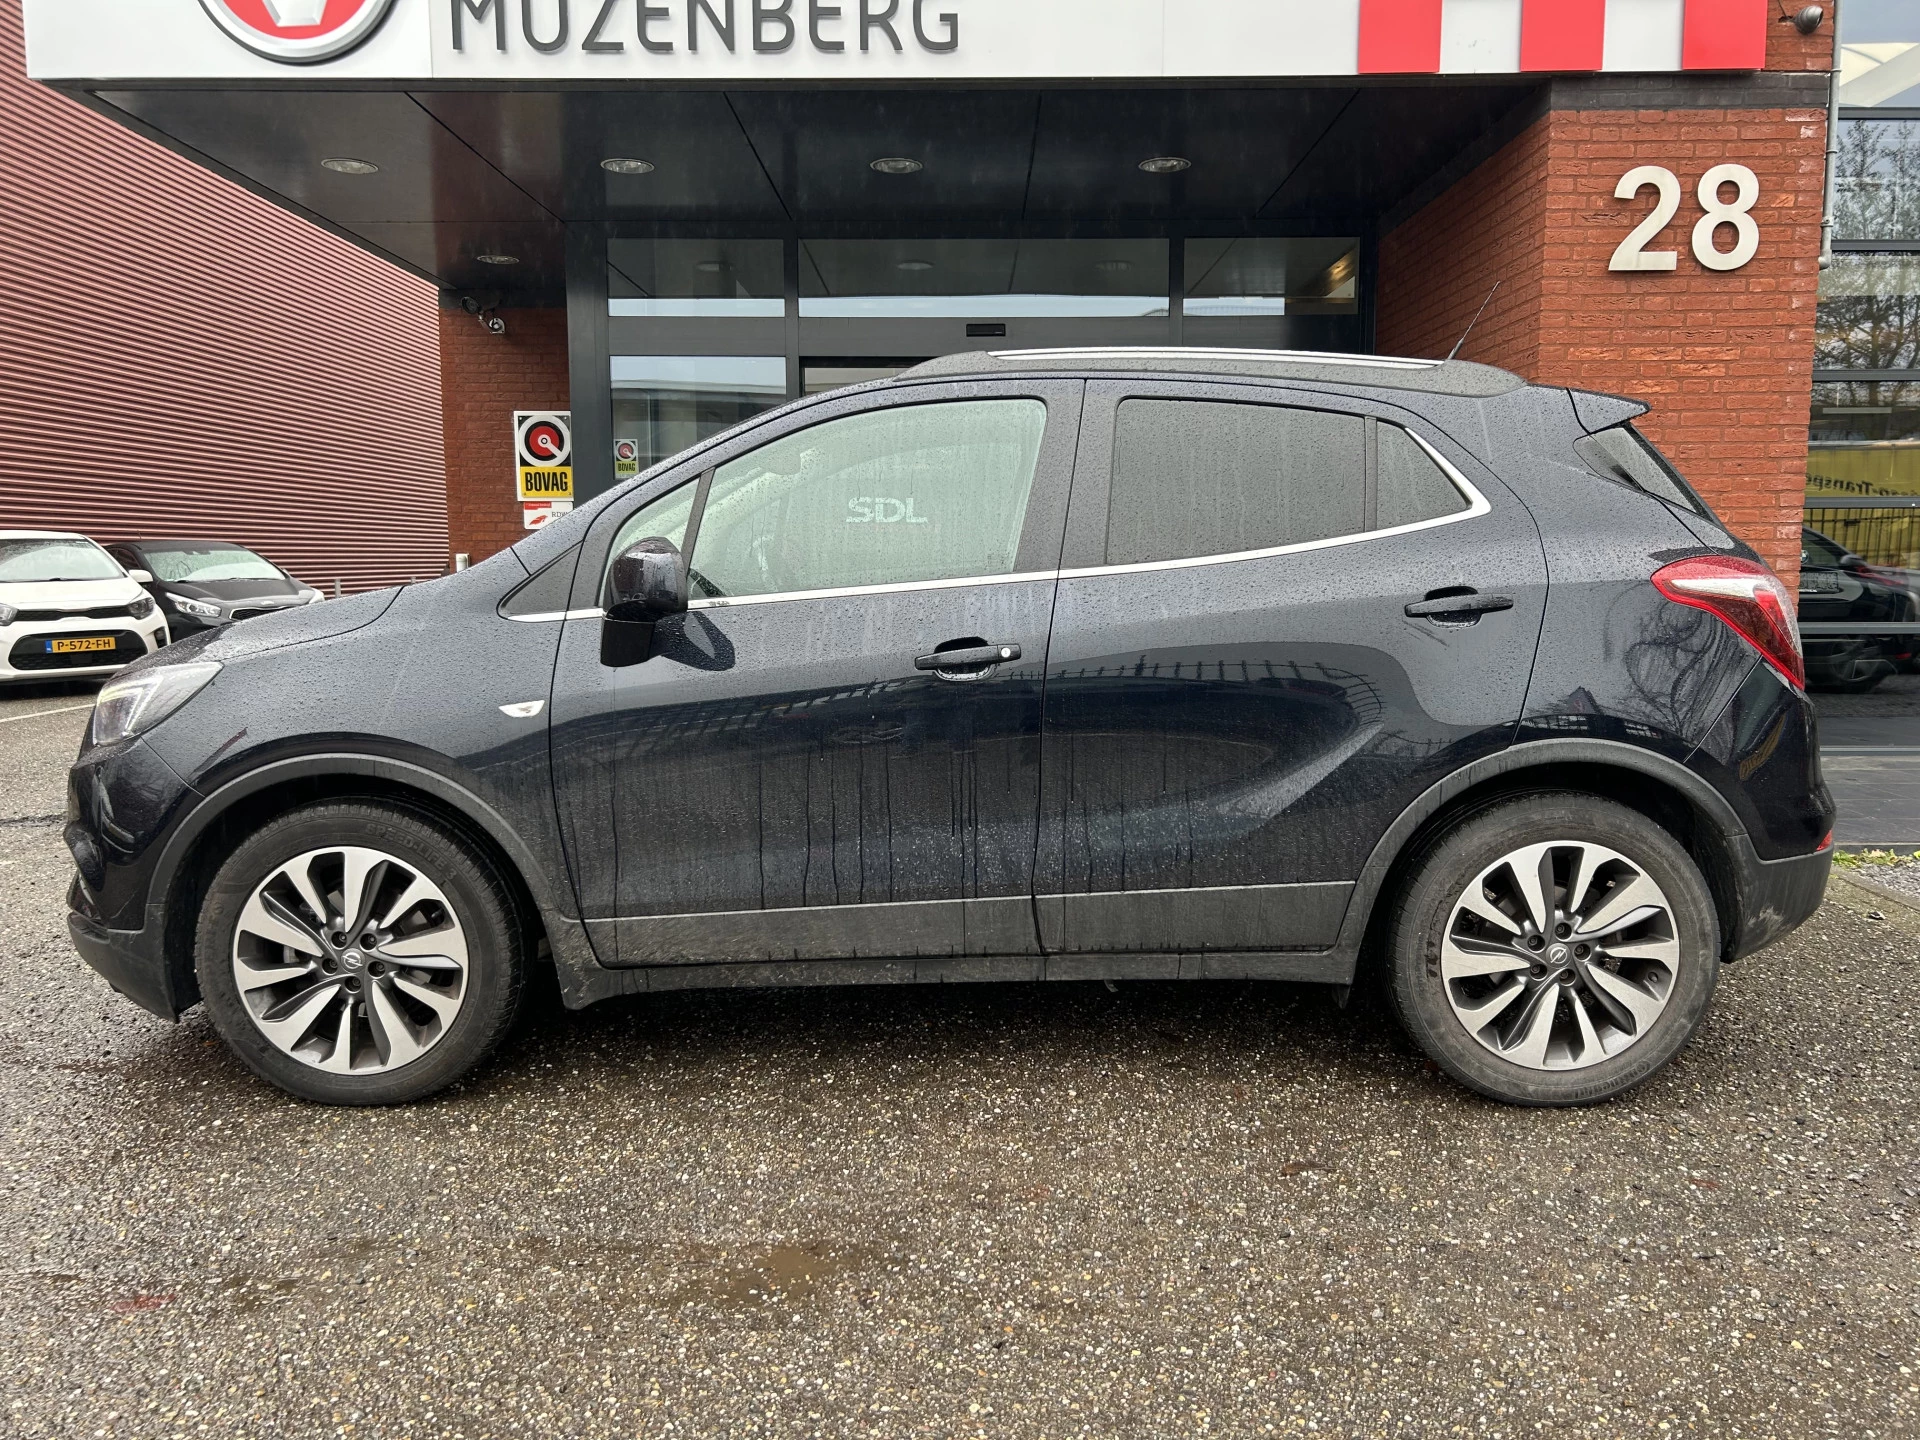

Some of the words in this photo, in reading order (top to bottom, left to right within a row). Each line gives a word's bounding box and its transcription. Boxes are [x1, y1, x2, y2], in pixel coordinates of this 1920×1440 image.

[452, 0, 959, 51] MUZENBERG
[1608, 163, 1760, 271] 28
[618, 462, 636, 472] BOVAG
[525, 471, 568, 492] BOVAG
[846, 497, 928, 523] SDL
[57, 638, 111, 651] P-572-FH
